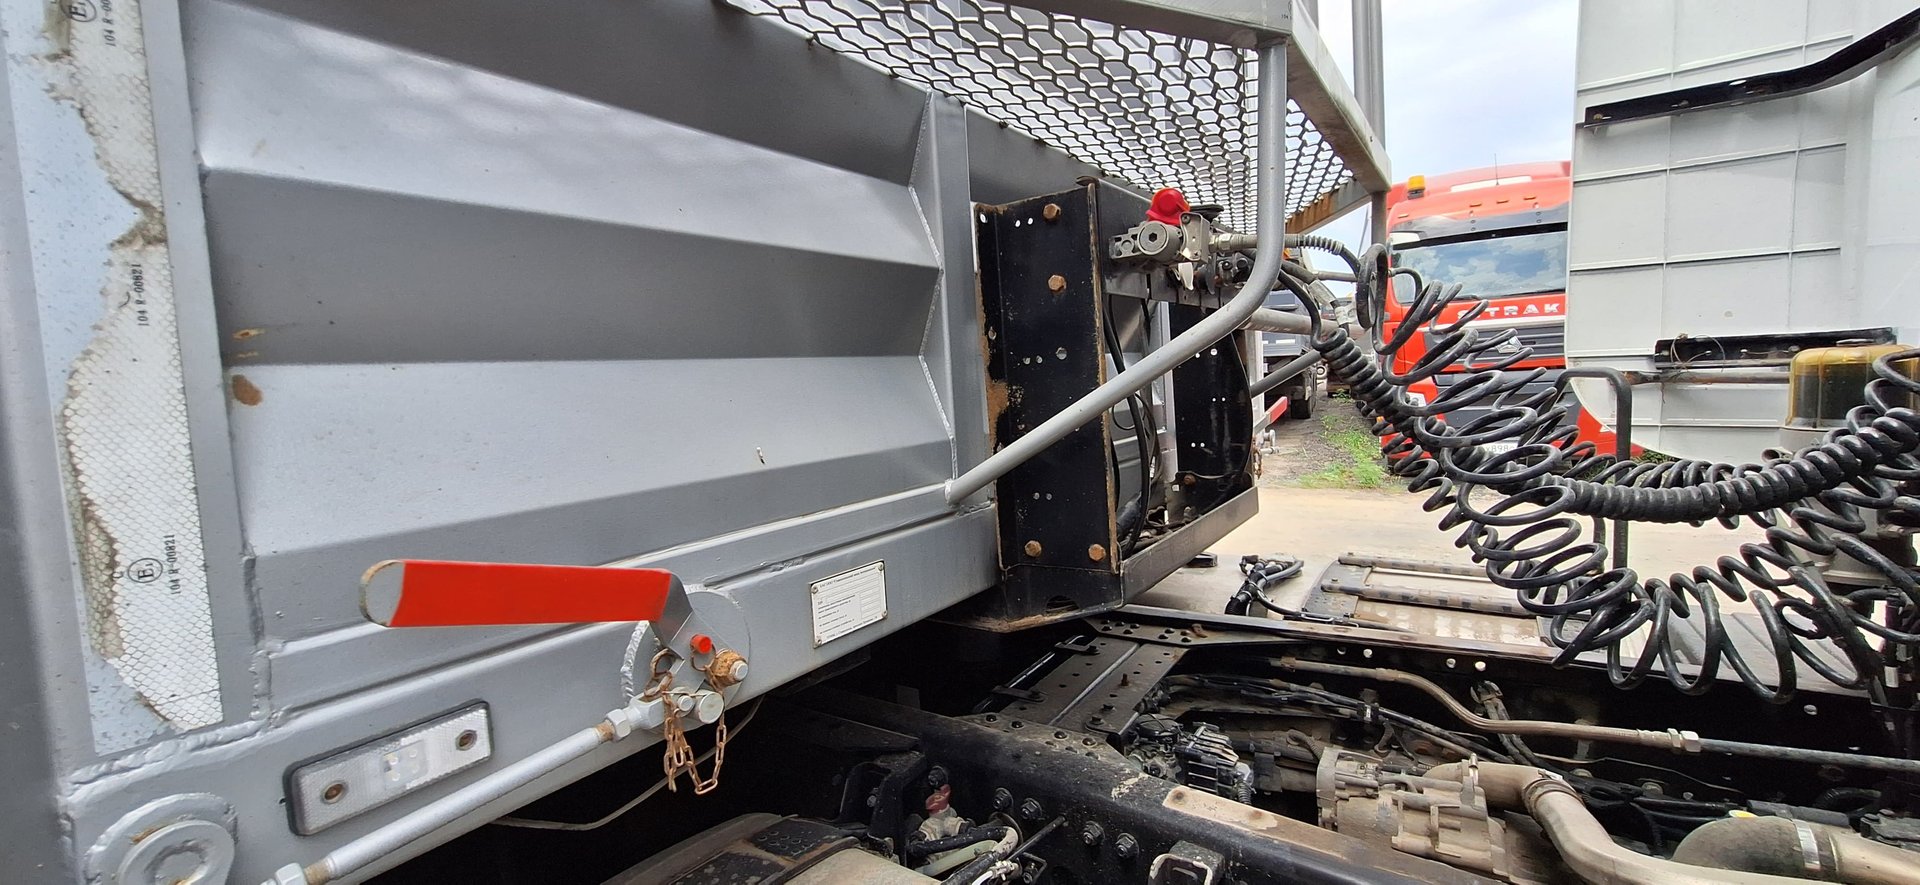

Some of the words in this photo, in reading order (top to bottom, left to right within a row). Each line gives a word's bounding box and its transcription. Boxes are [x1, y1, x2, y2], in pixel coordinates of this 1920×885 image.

[103, 29, 116, 46] 104
[131, 264, 147, 305] R-00821
[136, 310, 150, 327] 104
[1457, 303, 1560, 319] STRAK
[163, 534, 180, 575] R-00821
[169, 579, 182, 595] 104
